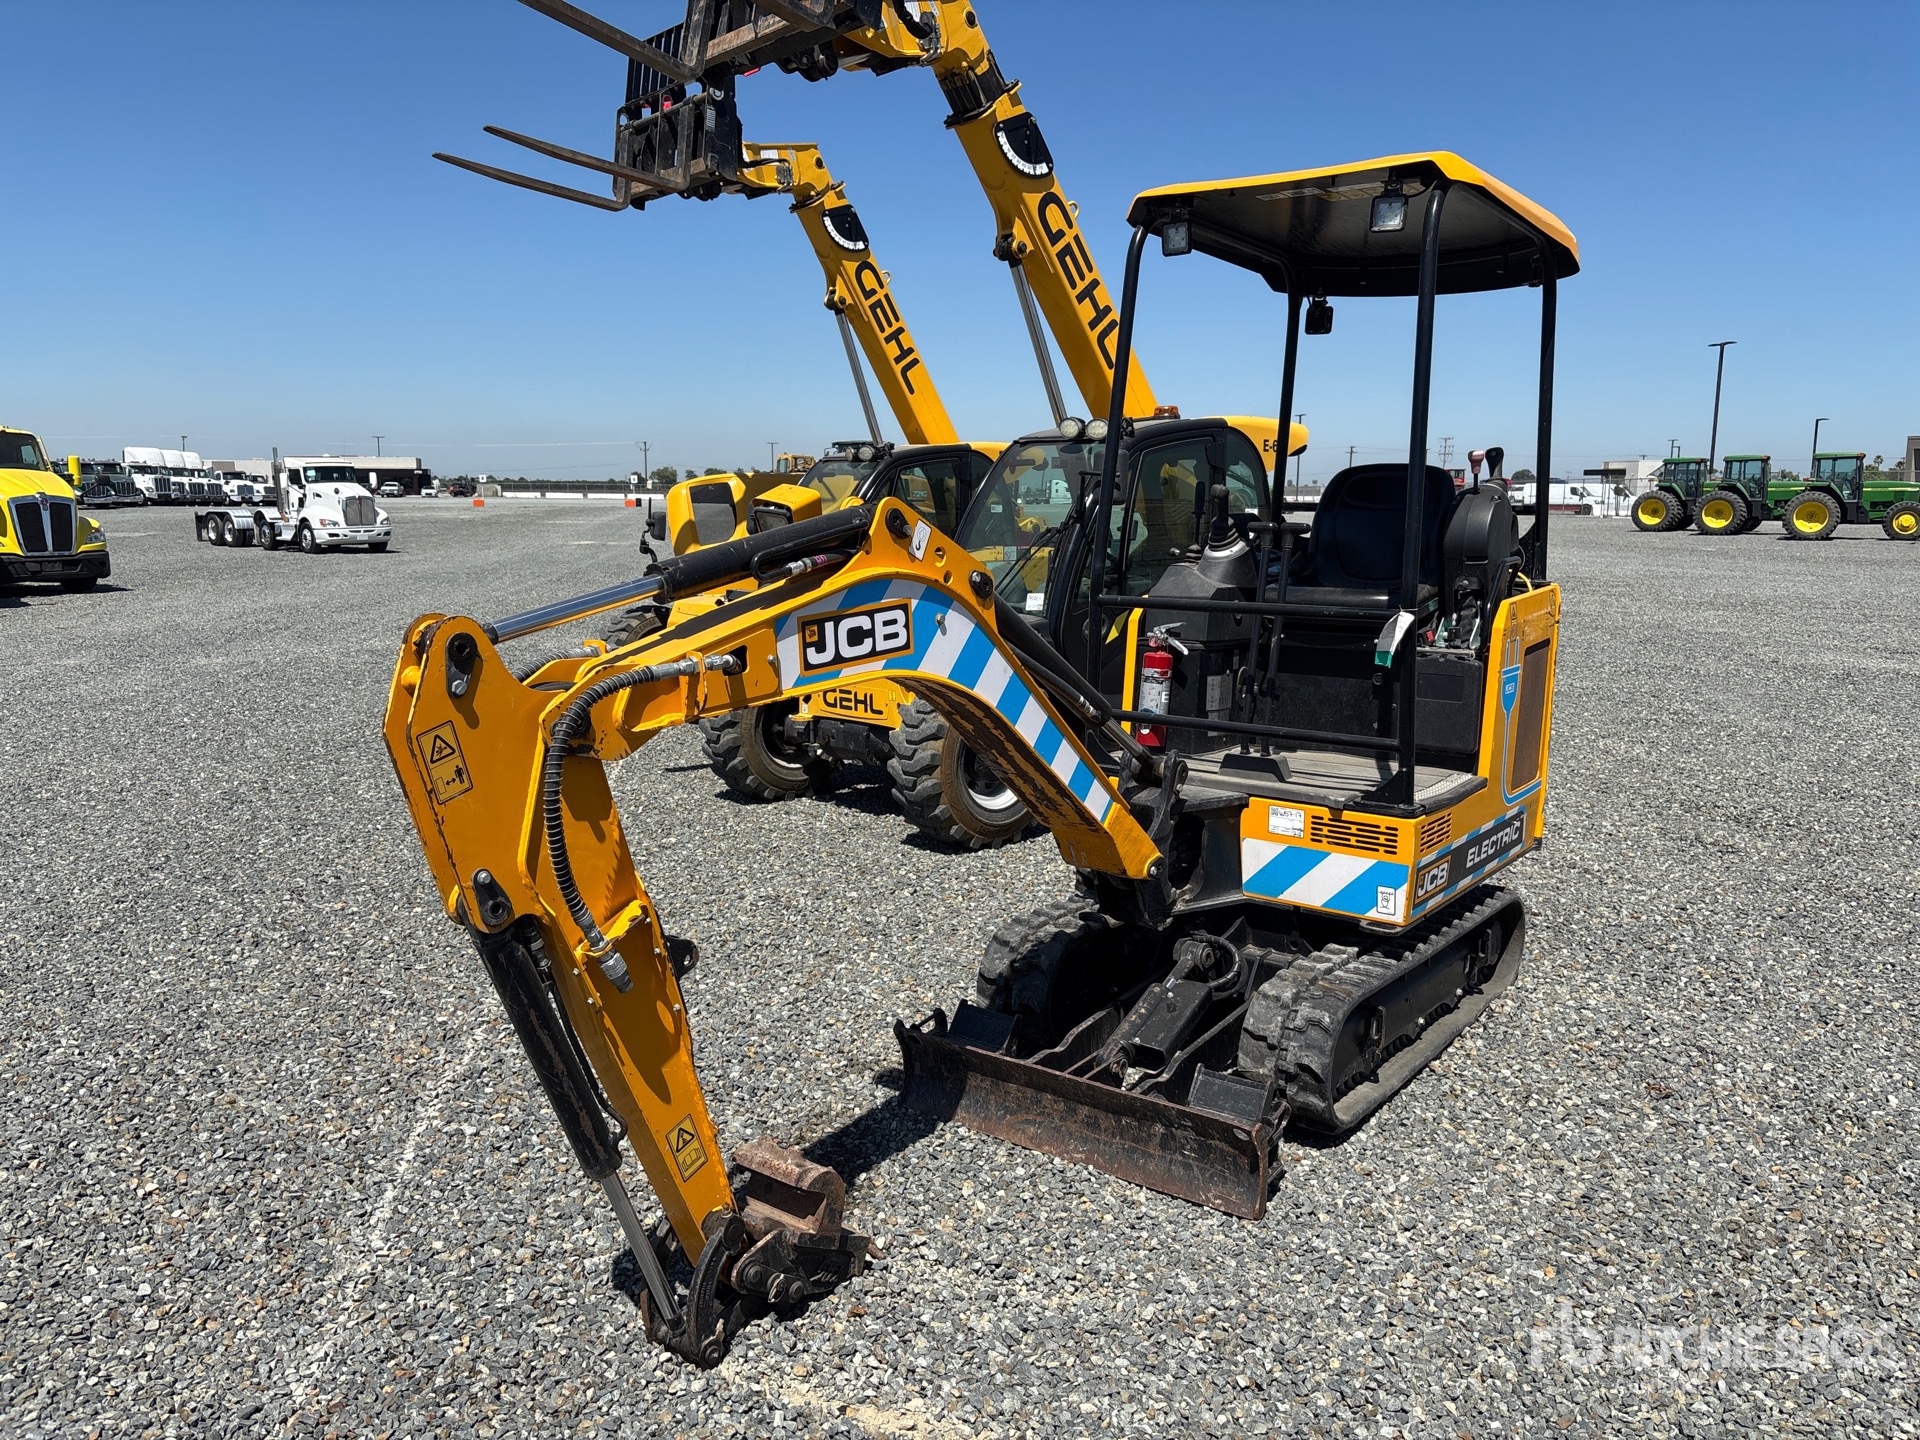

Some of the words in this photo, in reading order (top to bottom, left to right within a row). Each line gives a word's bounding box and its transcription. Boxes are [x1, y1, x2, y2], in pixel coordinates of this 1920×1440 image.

[1037, 191, 1119, 370] GEHL
[854, 260, 920, 395] GEHL
[806, 609, 908, 665] JCB
[822, 689, 884, 716] GEHL
[1417, 861, 1448, 897] JCB
[1465, 821, 1521, 869] ELECTRIC
